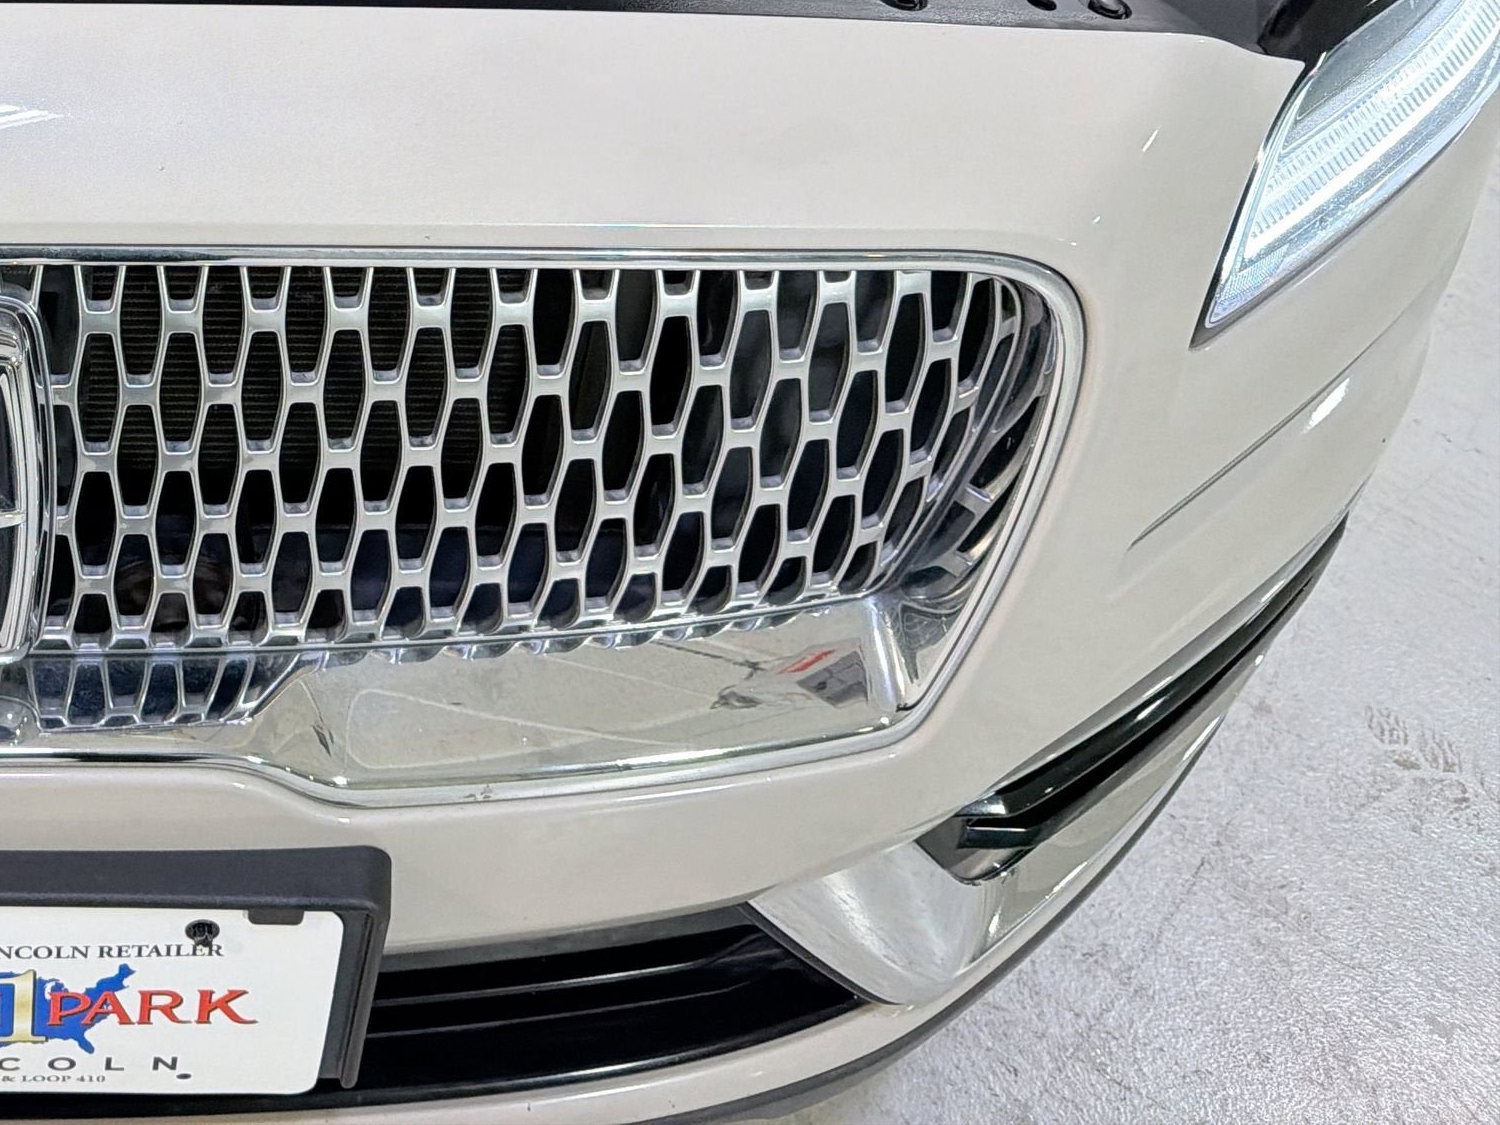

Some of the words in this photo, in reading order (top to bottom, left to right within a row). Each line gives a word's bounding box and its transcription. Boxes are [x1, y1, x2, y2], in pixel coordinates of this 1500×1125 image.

[98, 943, 224, 959] RETAILER
[47, 989, 259, 1026] PARK
[1, 1075, 16, 1083] &
[21, 1075, 72, 1083] LOOP
[75, 1075, 106, 1083] 410
